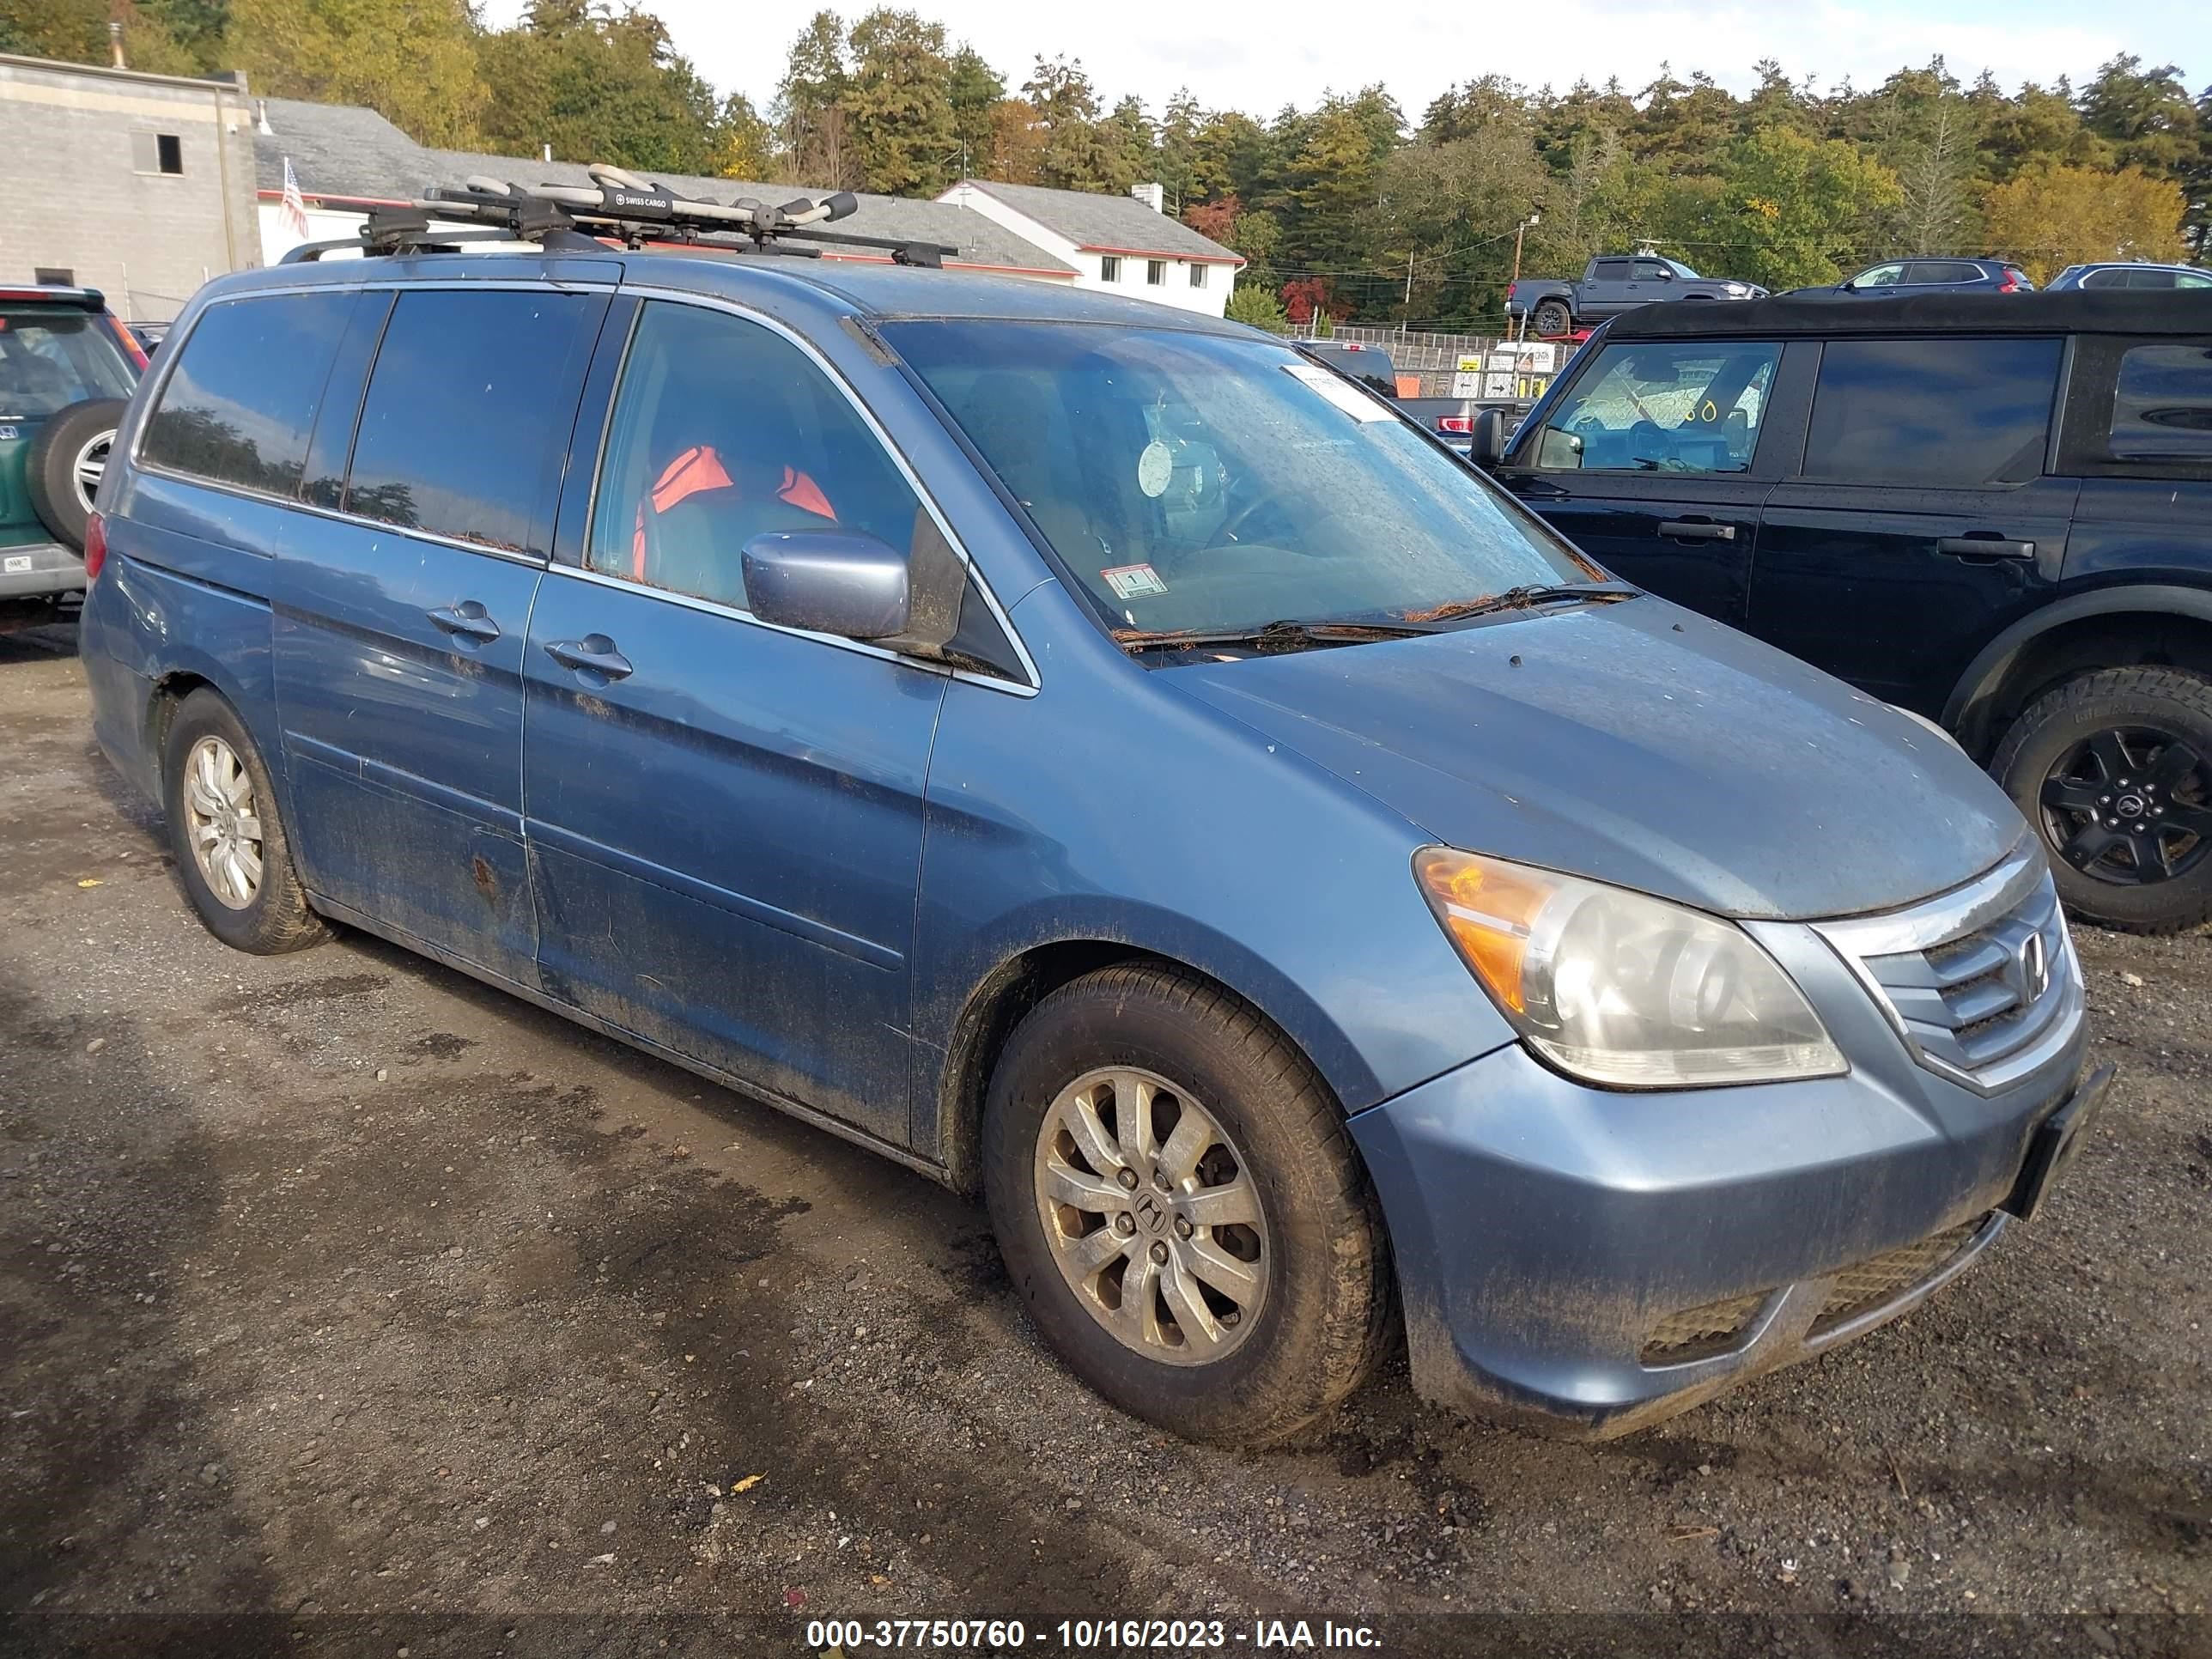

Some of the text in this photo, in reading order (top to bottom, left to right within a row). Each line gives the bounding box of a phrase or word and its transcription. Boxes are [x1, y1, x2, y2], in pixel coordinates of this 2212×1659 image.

[625, 197, 666, 209] SWISS CARGO
[1127, 574, 1138, 585] 1
